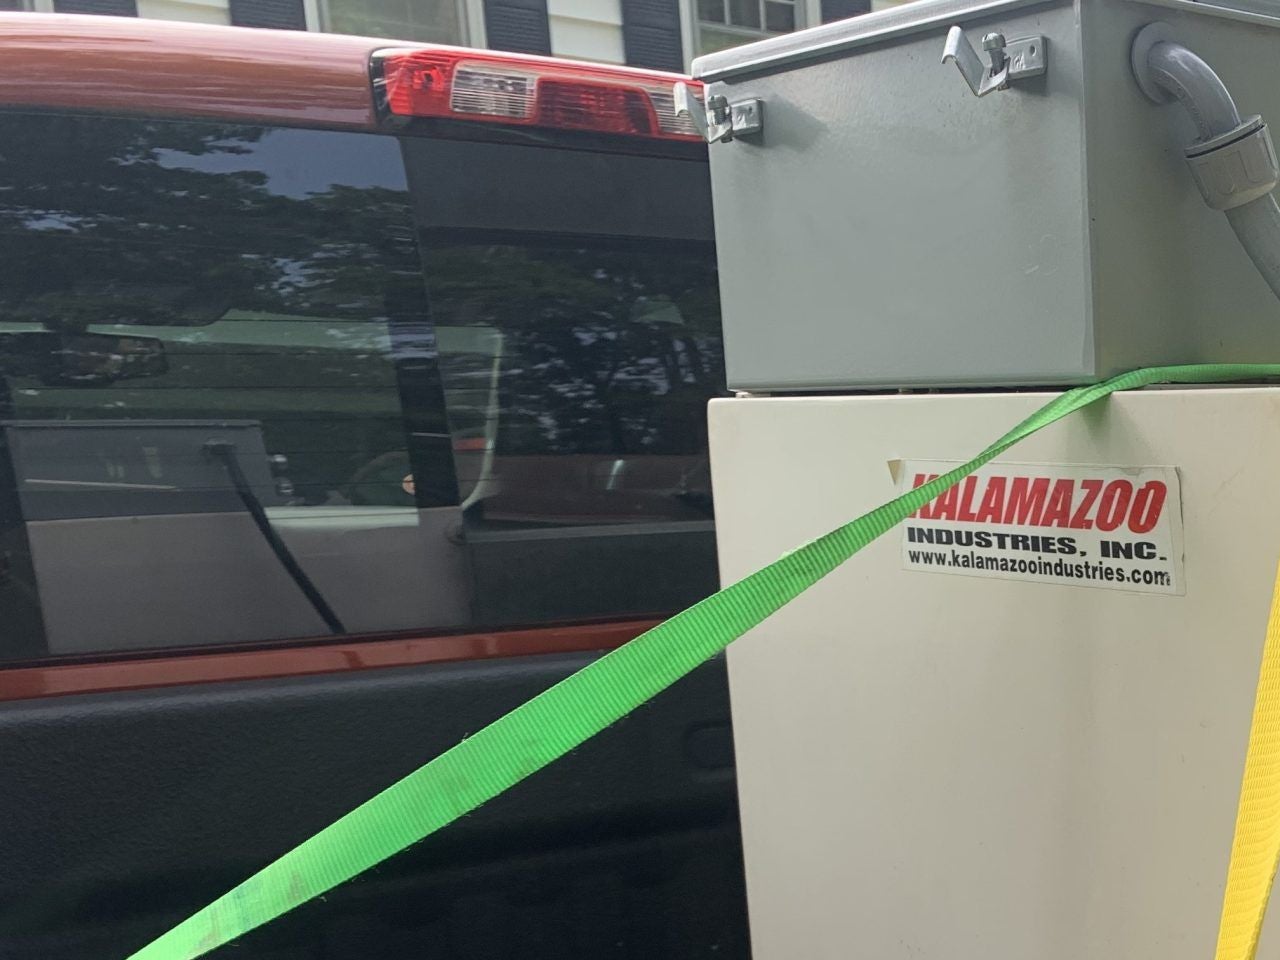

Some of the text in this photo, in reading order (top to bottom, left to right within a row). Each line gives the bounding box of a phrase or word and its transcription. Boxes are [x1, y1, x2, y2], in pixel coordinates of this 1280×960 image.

[907, 527, 1167, 561] INDUSTRIES, INC.
[908, 549, 1171, 586] www.kalamazooindustries.com
